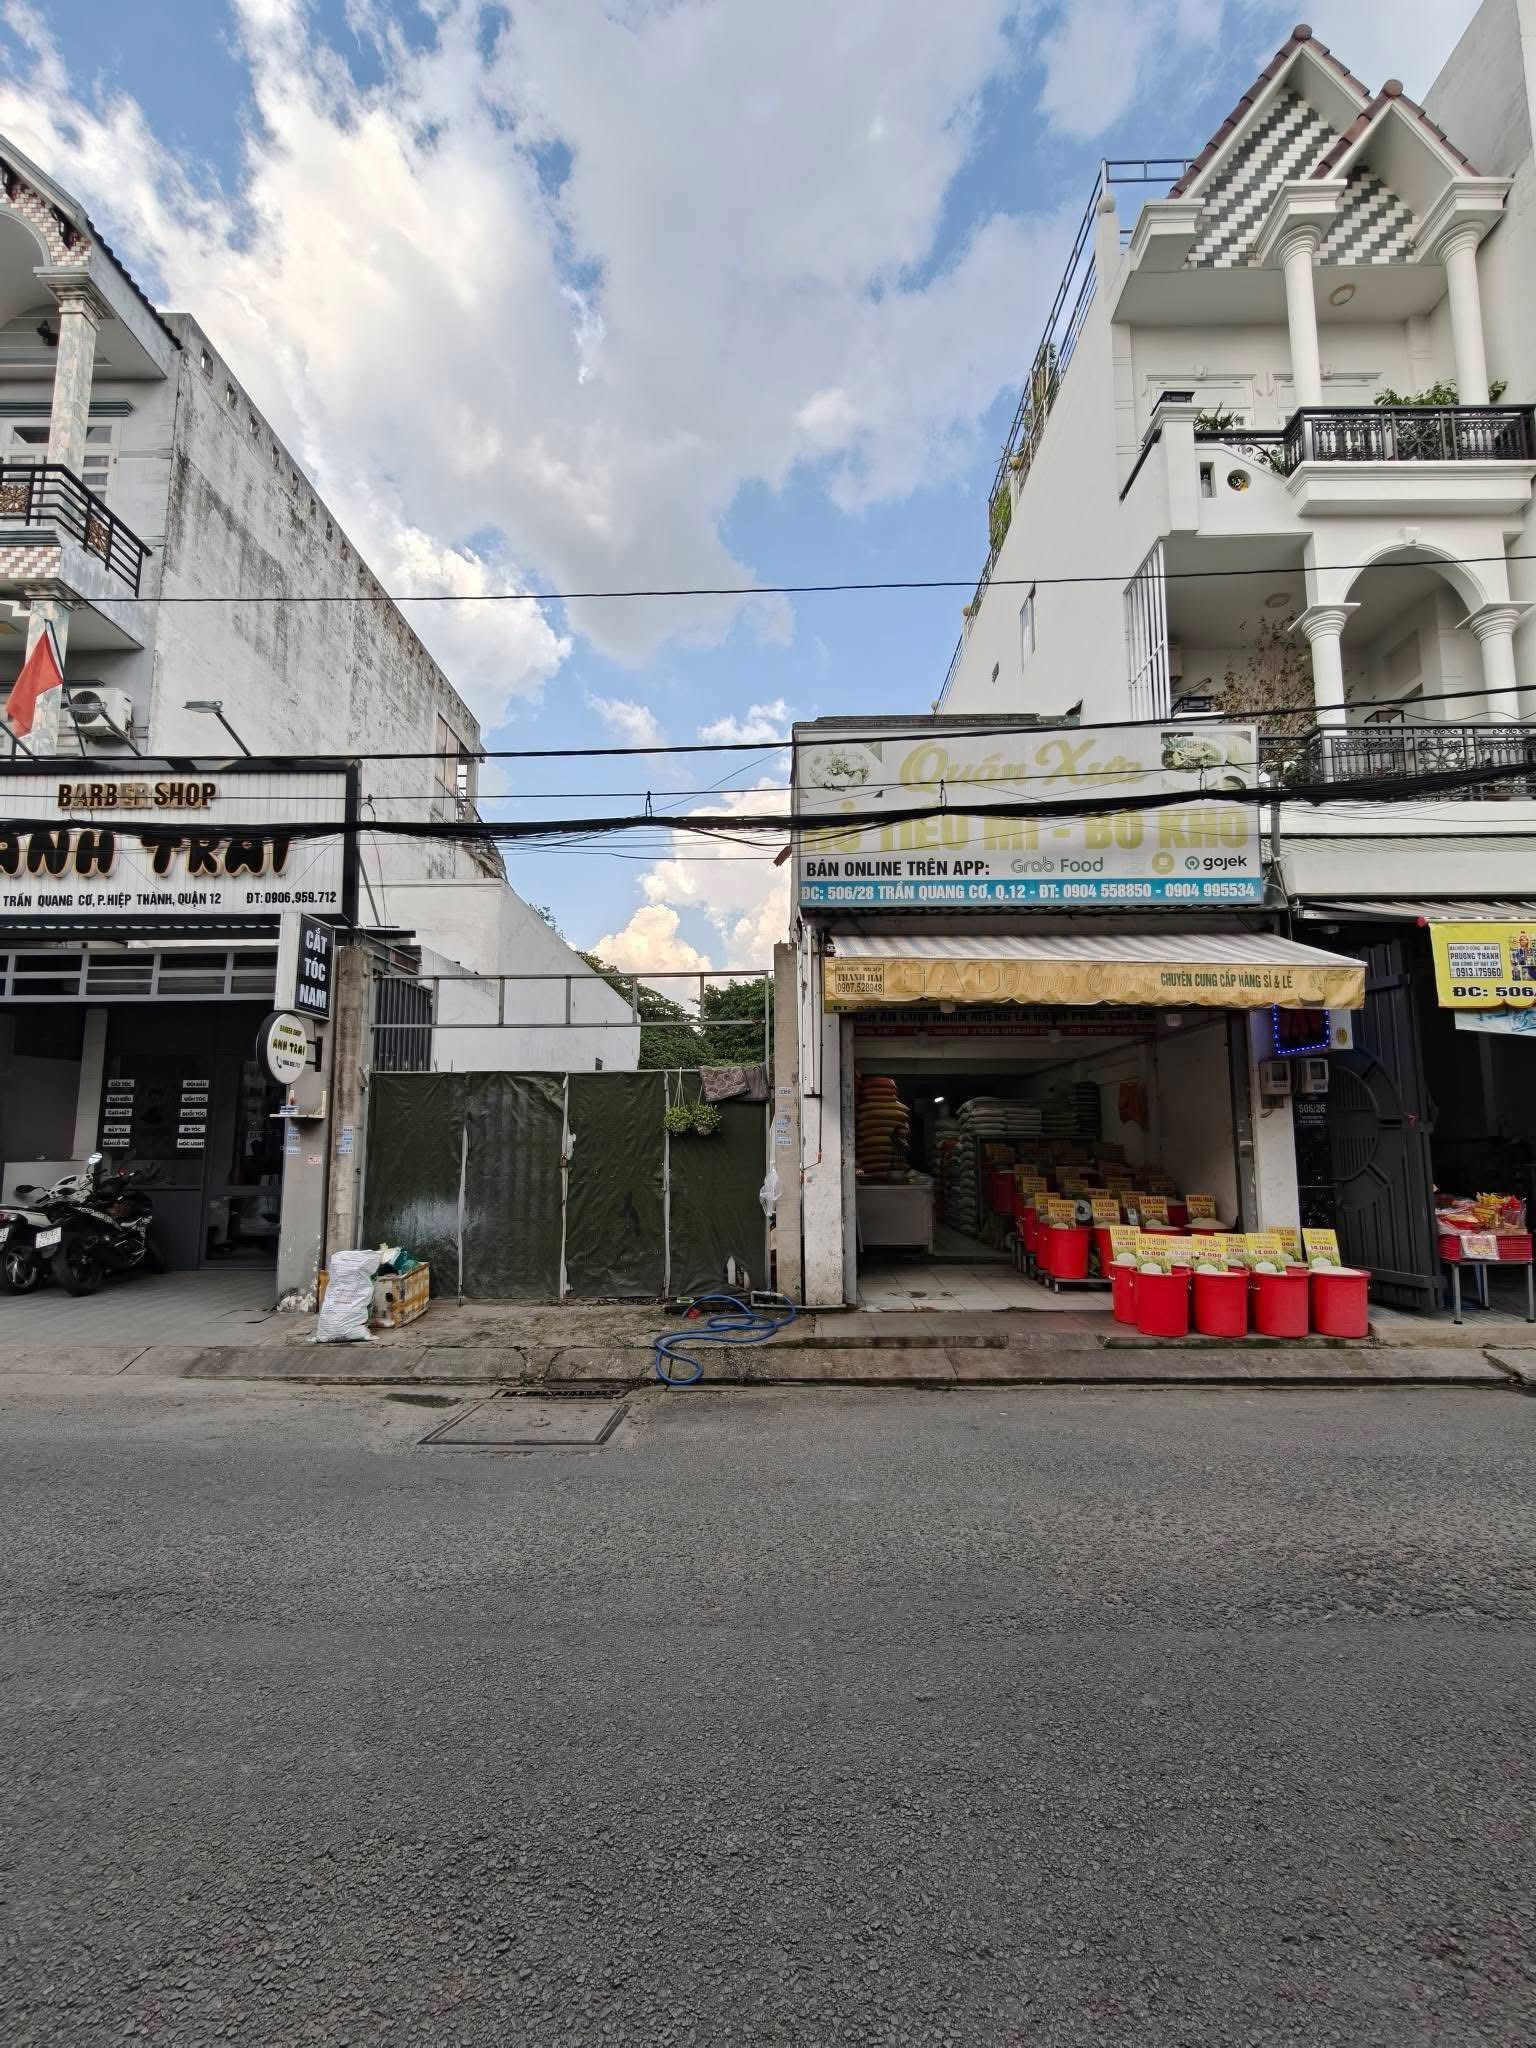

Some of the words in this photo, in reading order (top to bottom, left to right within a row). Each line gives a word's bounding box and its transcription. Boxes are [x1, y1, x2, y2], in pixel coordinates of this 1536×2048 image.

[57, 782, 150, 808] BARBER
[154, 781, 216, 808] SHOP
[1158, 807, 1248, 848] KHO
[806, 859, 839, 877] BÁN
[844, 860, 902, 876] ONLINE
[907, 858, 948, 875] TRÊN
[953, 860, 990, 876] APP:
[1011, 856, 1054, 874] Grab
[1061, 857, 1104, 873] Food
[1203, 855, 1247, 870] gojek
[38, 894, 73, 908] QUANG
[178, 891, 206, 908] QUẬN
[210, 893, 222, 904] 12
[827, 886, 874, 900] 506/28
[919, 885, 964, 901] QUANG
[995, 884, 1026, 900] Q.12
[1039, 884, 1060, 898] ĐT:
[1063, 884, 1096, 897] 0904
[1101, 883, 1151, 897] 558850
[1165, 883, 1199, 897] 0904
[1203, 883, 1255, 897] 995534
[305, 927, 328, 955] CẮT
[304, 957, 326, 982] TÓC
[1161, 970, 1192, 987] CHUYÊN
[1194, 973, 1218, 987] CUNG
[1220, 969, 1236, 988] CẤP
[1456, 967, 1501, 977] 0913.175960
[299, 983, 327, 1009] NAM
[837, 982, 883, 993] 0907.528948
[1452, 986, 1489, 997] ĐC:
[272, 1038, 287, 1051] ANH
